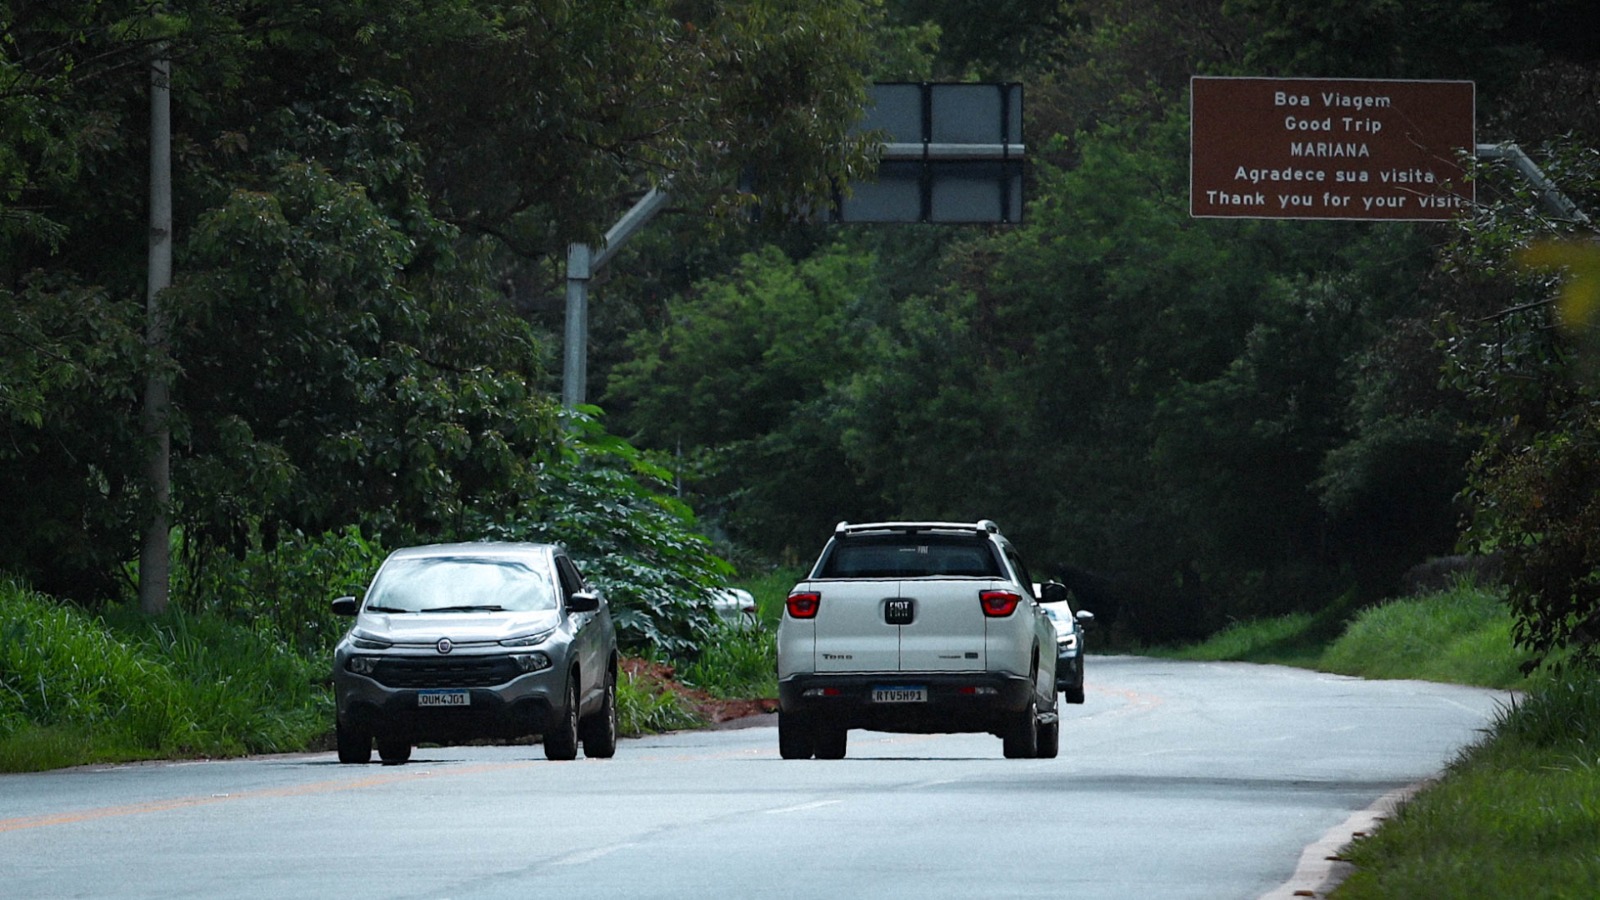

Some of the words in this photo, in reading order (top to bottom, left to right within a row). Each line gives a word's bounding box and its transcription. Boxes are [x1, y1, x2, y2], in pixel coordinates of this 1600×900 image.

[1274, 91, 1311, 107] Boa
[1321, 92, 1391, 111] Viagem
[1285, 116, 1331, 131] Good
[1342, 117, 1382, 134] Trip
[1290, 142, 1370, 157] MARIANA
[1234, 166, 1326, 184] Agradece
[1335, 171, 1369, 182] sua
[1380, 168, 1434, 183] visita
[1206, 190, 1265, 206] Thank
[1278, 194, 1313, 209] you
[1323, 192, 1350, 206] for
[1363, 194, 1406, 210] your
[1418, 193, 1461, 208] visit
[876, 690, 922, 701] RTV5H91
